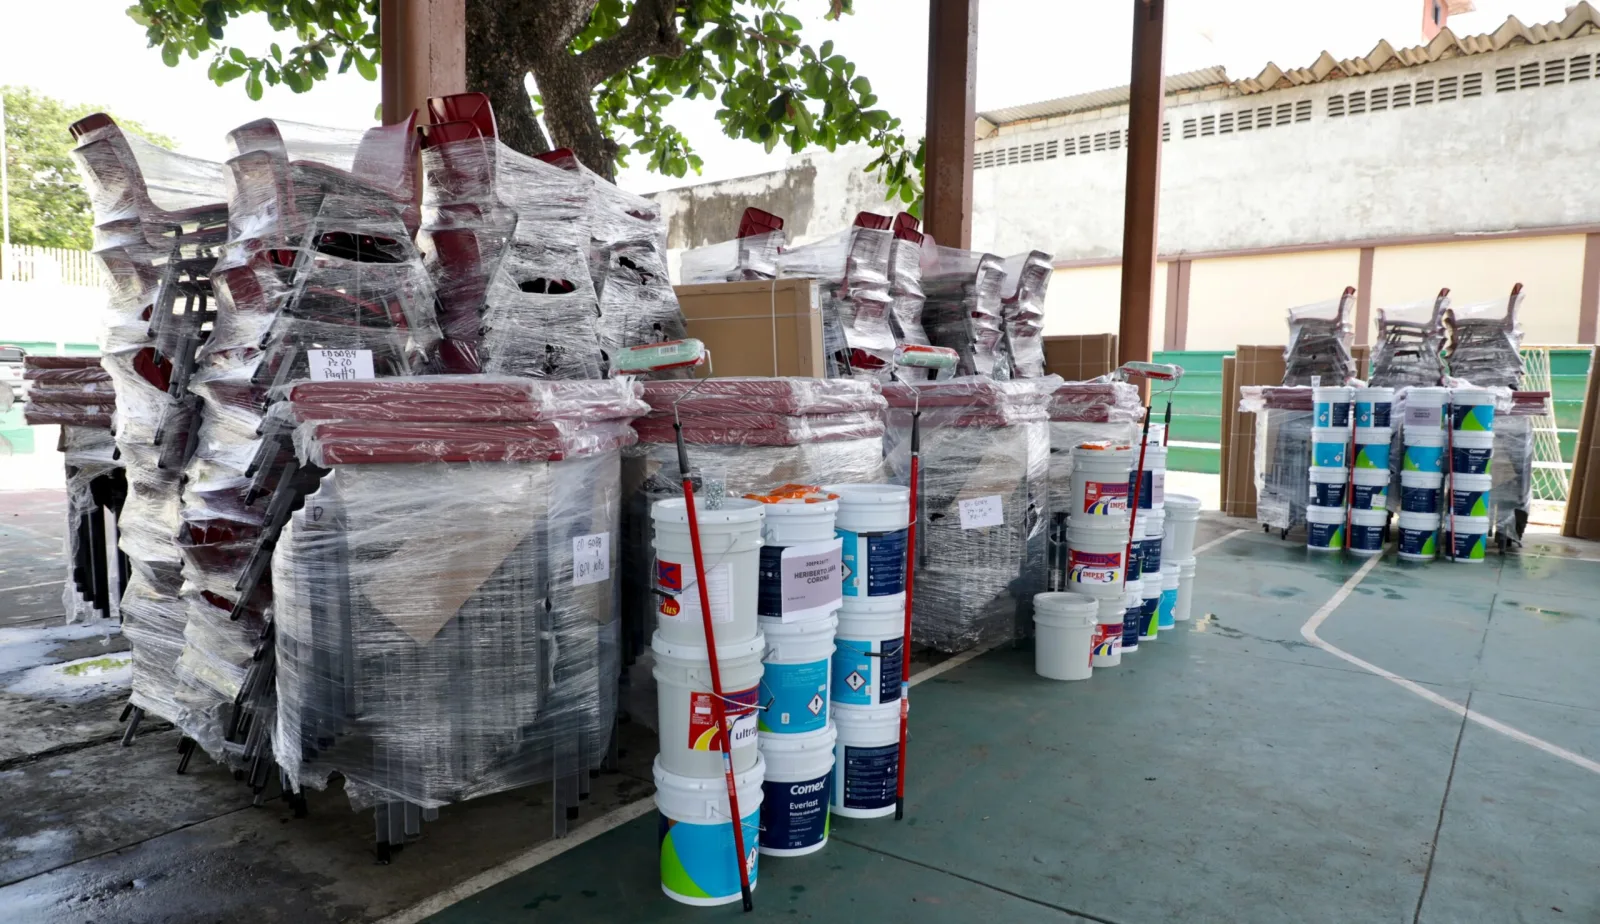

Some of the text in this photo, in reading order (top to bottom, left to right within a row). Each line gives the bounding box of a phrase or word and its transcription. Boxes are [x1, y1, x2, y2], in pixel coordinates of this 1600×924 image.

[794, 568, 827, 579] HERIBERTO
[790, 777, 826, 795] Comex
[790, 799, 818, 810] Everlast
